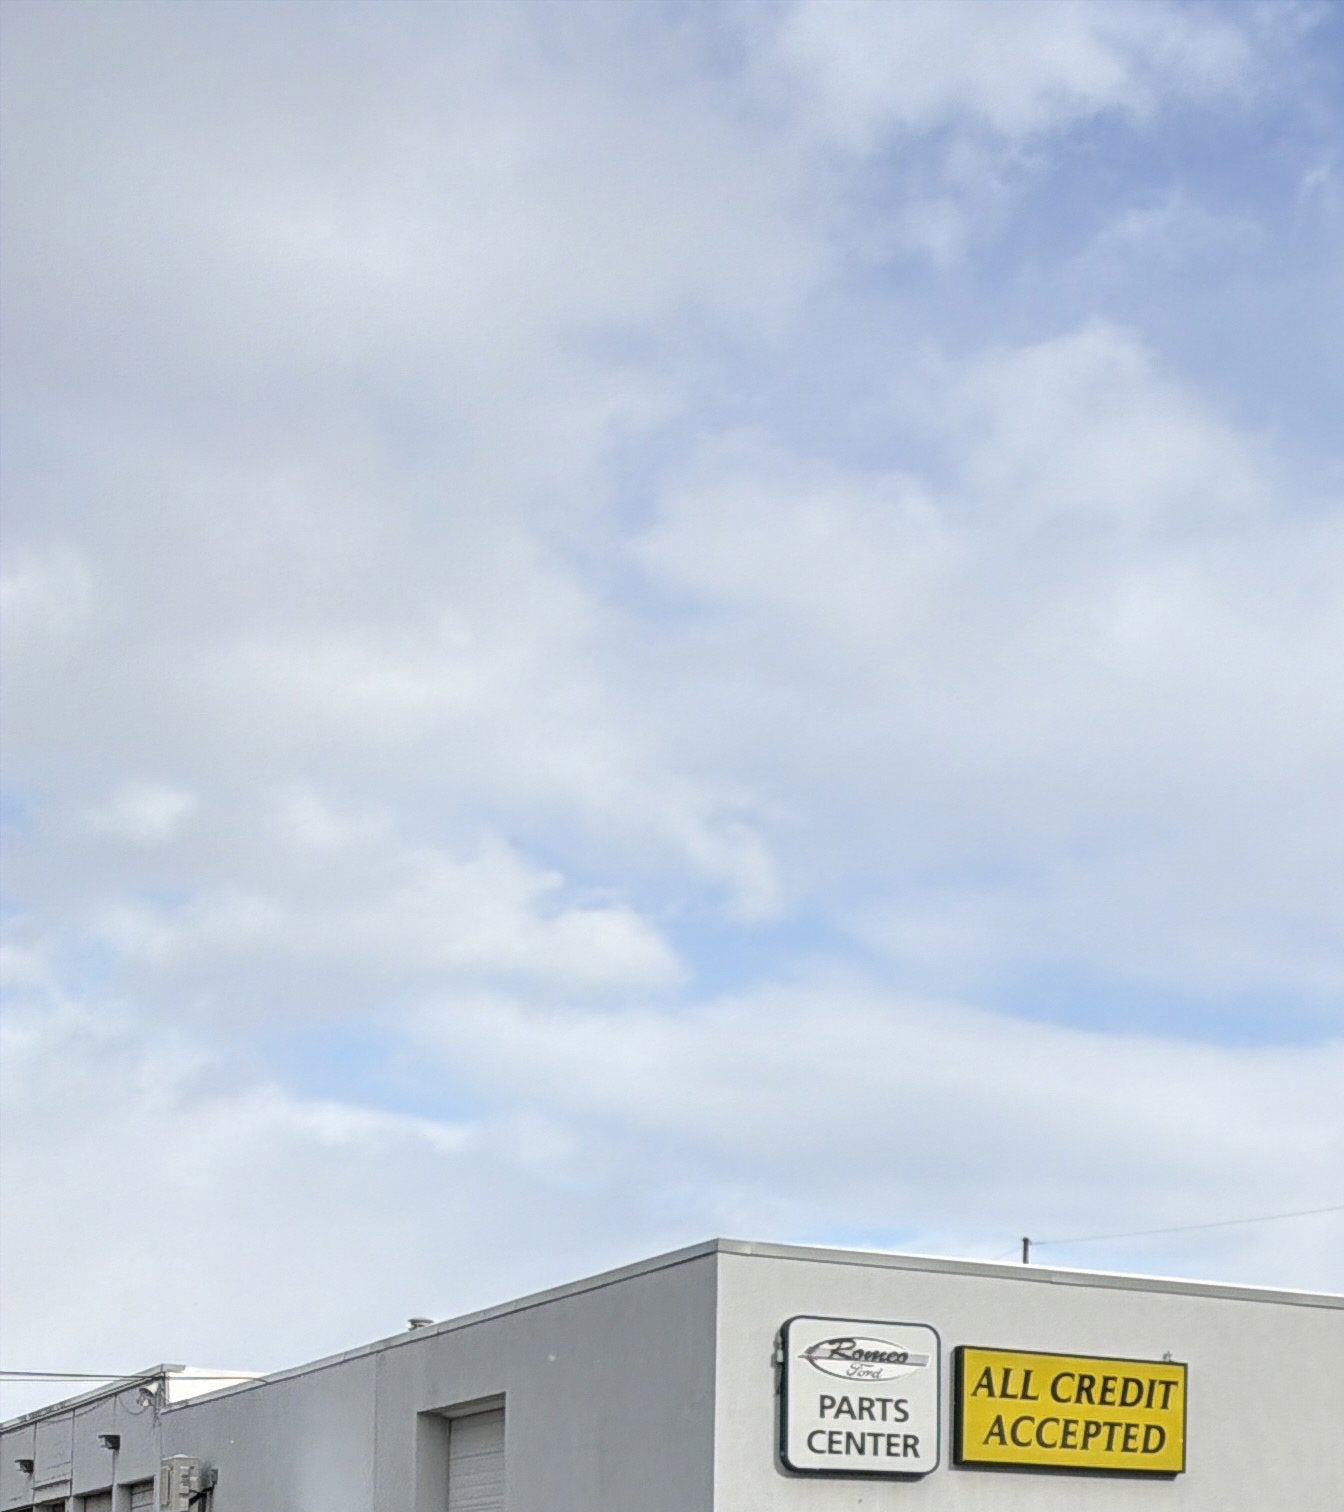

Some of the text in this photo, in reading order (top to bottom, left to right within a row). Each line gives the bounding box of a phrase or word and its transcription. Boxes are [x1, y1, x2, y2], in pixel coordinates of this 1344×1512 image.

[826, 1338, 909, 1364] Romeo
[845, 1363, 883, 1379] Ford
[970, 1366, 1179, 1410] ALL CREDIT
[818, 1395, 909, 1423] PARTS
[807, 1430, 921, 1459] CENTER
[982, 1414, 1167, 1454] ACCEPTED
